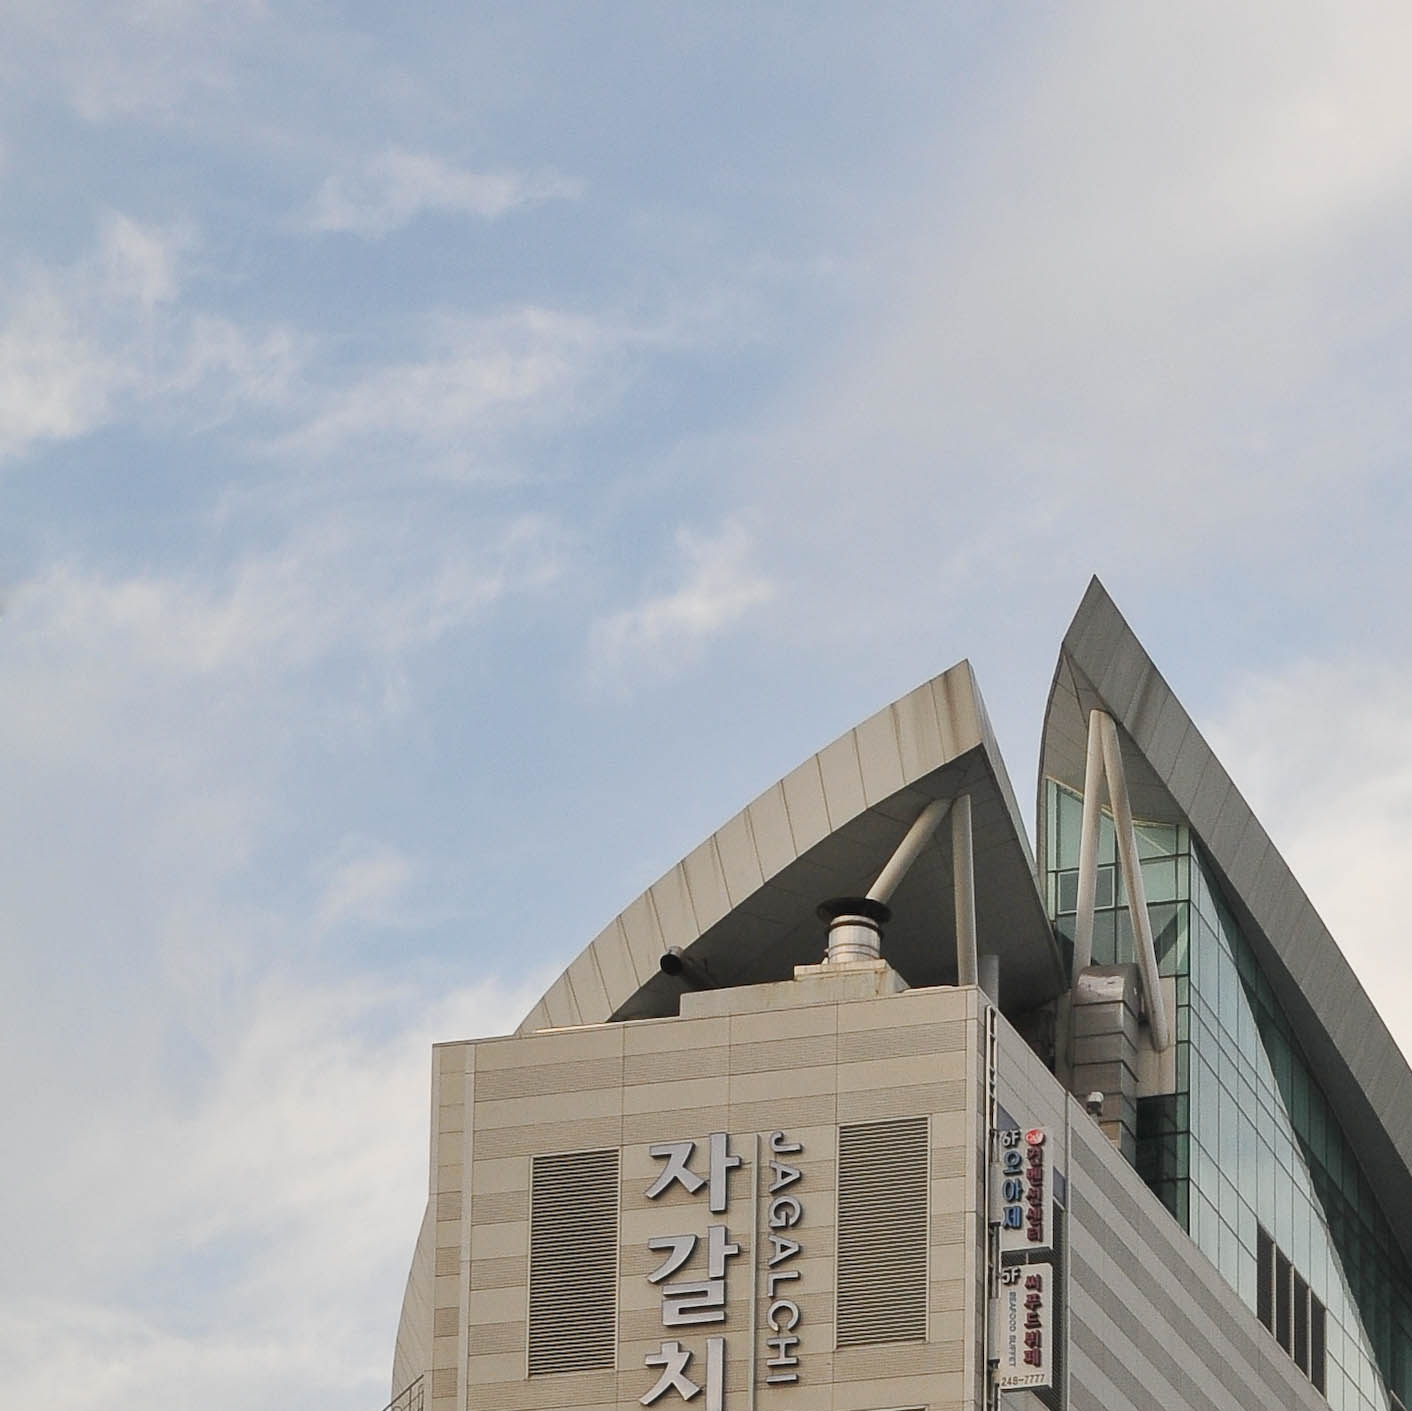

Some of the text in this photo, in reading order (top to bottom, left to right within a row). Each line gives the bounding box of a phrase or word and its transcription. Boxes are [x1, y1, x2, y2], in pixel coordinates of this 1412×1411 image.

[1002, 1130, 1020, 1147] 6F
[1003, 1149, 1023, 1229] 오아제
[764, 1130, 806, 1385] JAGALCHI
[1001, 1267, 1021, 1286] 5F
